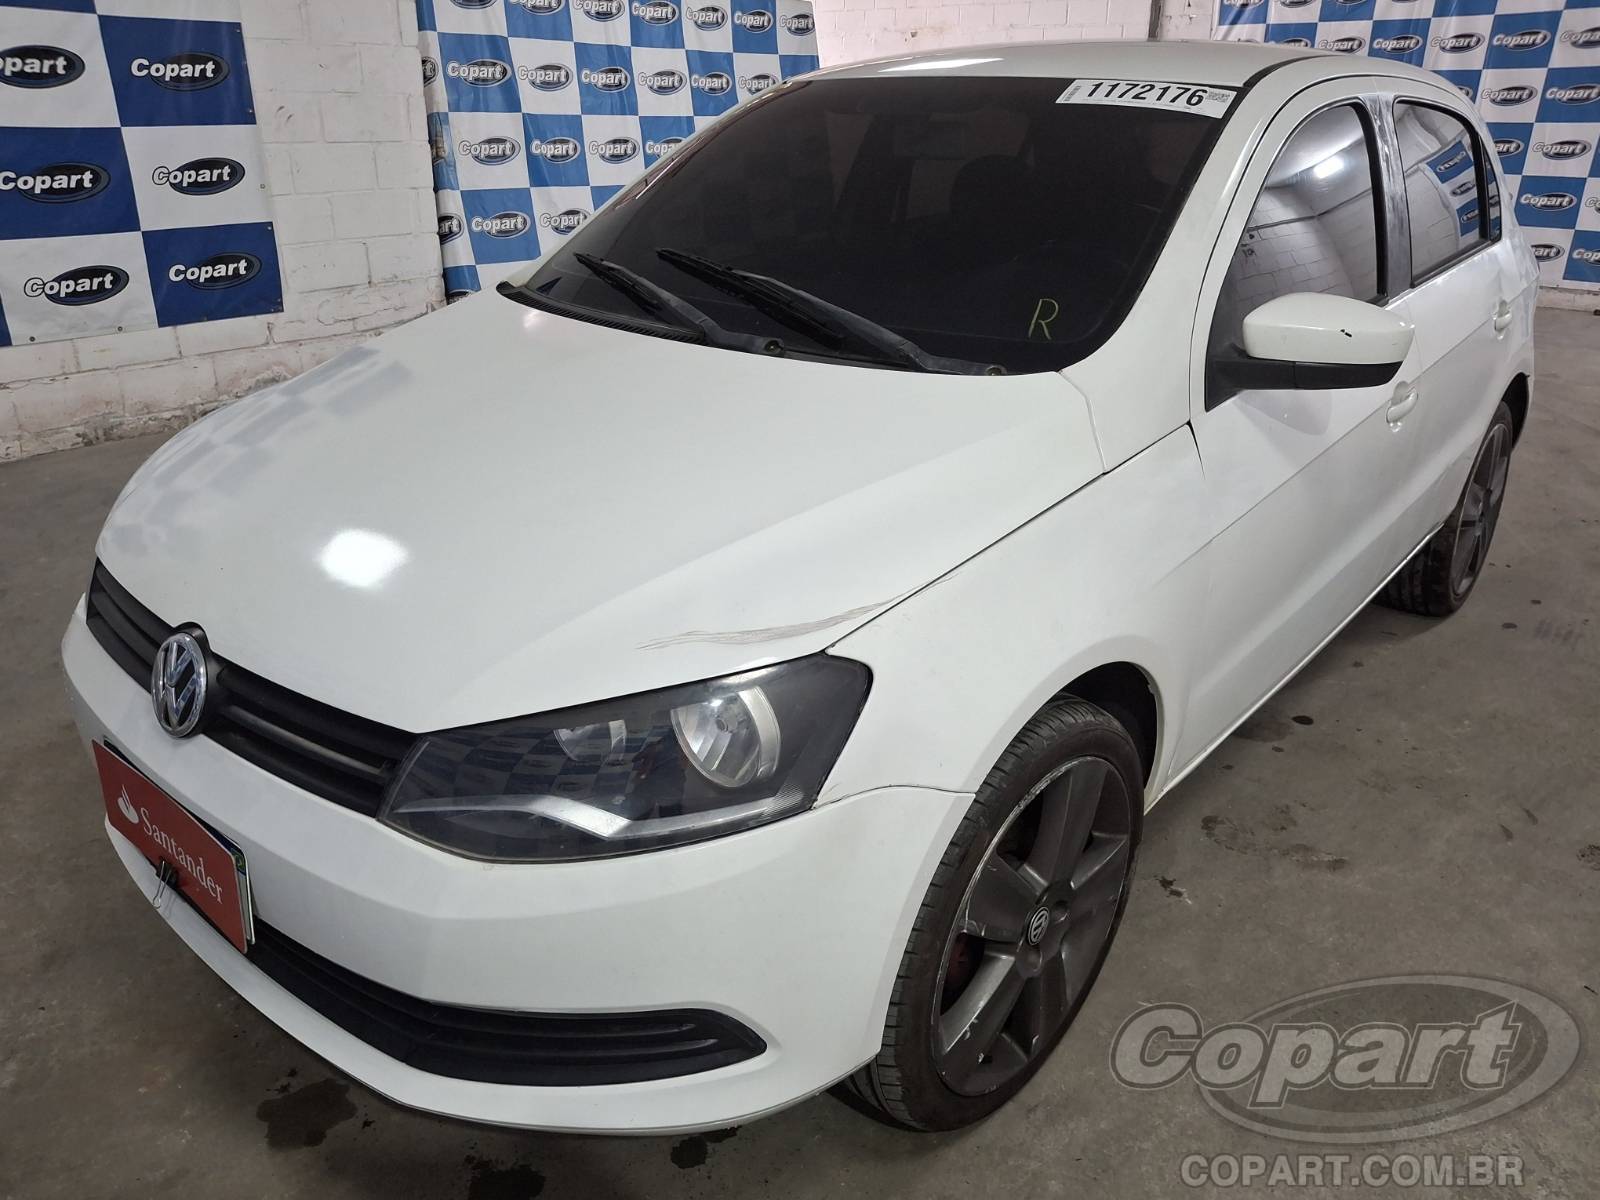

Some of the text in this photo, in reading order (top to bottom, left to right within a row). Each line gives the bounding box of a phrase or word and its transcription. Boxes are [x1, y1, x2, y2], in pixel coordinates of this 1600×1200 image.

[632, 3, 673, 18] Copart
[686, 7, 723, 22] Copart
[734, 12, 768, 28] Copart
[780, 15, 814, 30] Copart
[1319, 39, 1359, 51] Copart
[1374, 38, 1417, 51] Copart
[1432, 36, 1477, 50] Copart
[1493, 33, 1544, 48] Copart
[1561, 31, 1600, 44] Copa
[0, 56, 67, 76] part
[131, 58, 216, 81] Copart
[447, 61, 503, 80] Copart
[518, 66, 566, 83] Copart
[582, 68, 626, 86] Copart
[638, 72, 680, 89] Copart
[691, 74, 727, 89] Copart
[1087, 82, 1208, 107] 1172176
[1481, 87, 1529, 101] Copart
[1545, 87, 1600, 101] Copart
[459, 140, 513, 158] Copart
[531, 140, 575, 157] Copart
[589, 141, 633, 157] Copart
[1532, 142, 1581, 155] Copart
[0, 170, 93, 194] Copart
[152, 162, 232, 188] Copart
[1521, 193, 1570, 207] Copart
[472, 213, 524, 231] Copart
[168, 258, 248, 283] Copart
[24, 272, 114, 298] Copart
[1028, 298, 1059, 340] R
[141, 807, 223, 905] Santander
